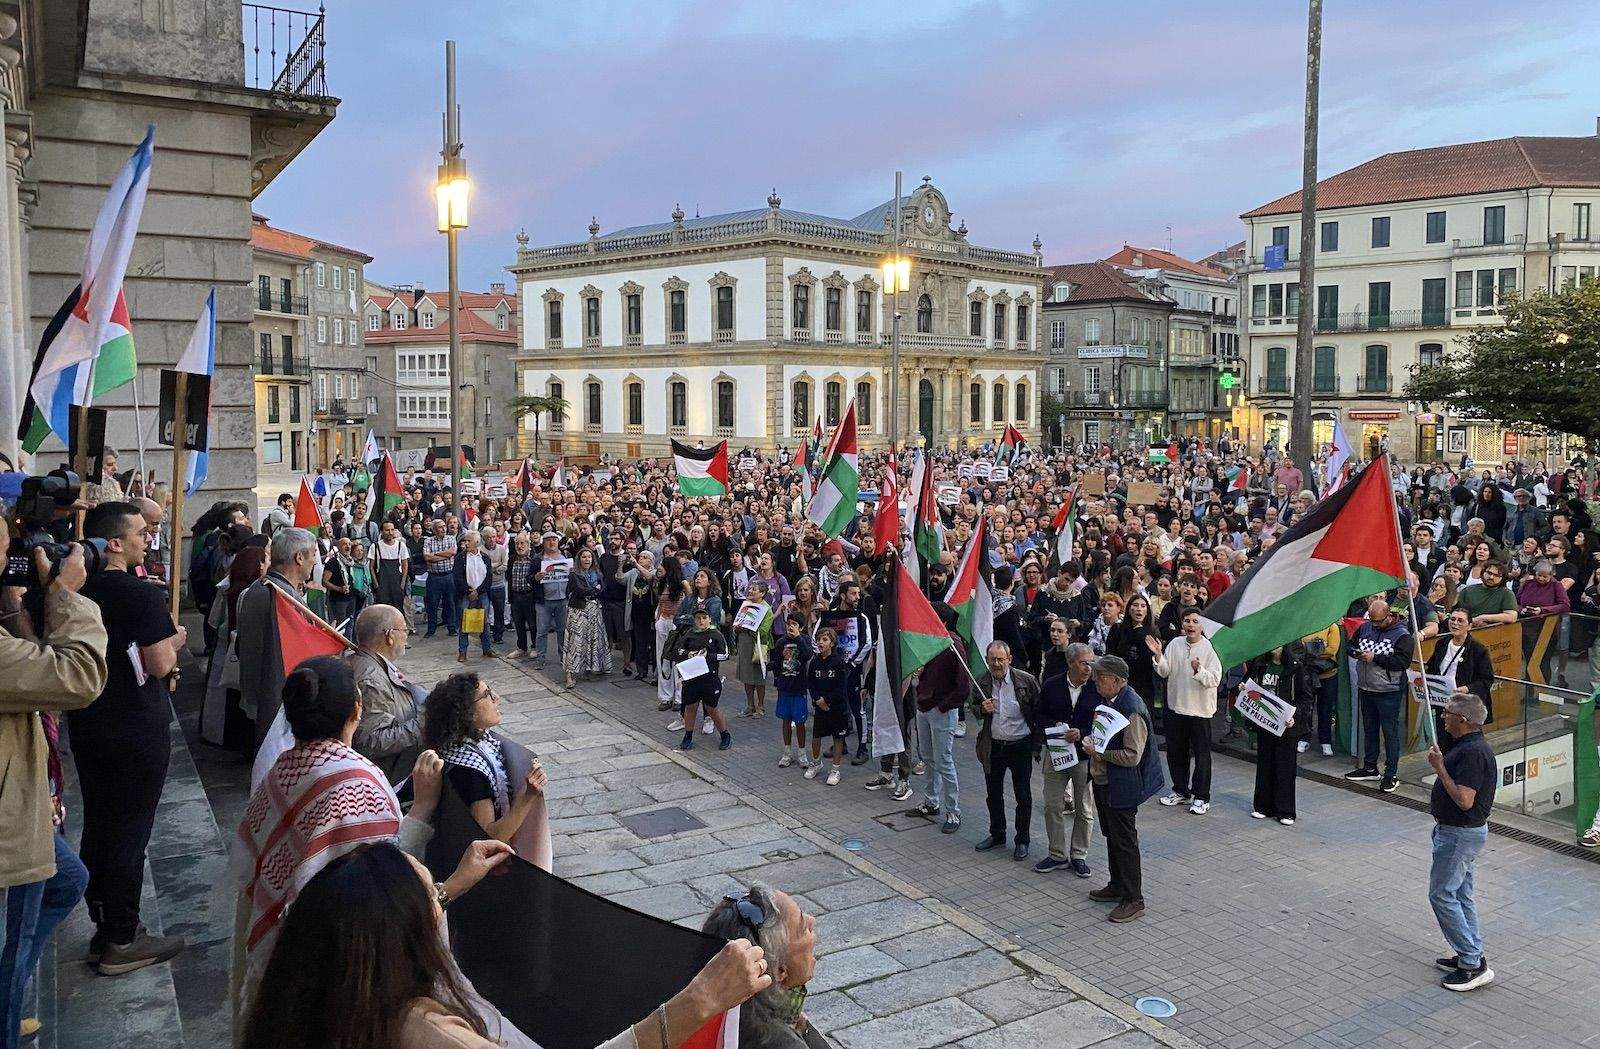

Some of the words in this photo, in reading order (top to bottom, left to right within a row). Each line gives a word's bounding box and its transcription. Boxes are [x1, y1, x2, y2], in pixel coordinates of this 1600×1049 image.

[1242, 695, 1261, 712] GALIZA
[1239, 701, 1251, 713] CON
[1249, 709, 1280, 732] PALESTINA
